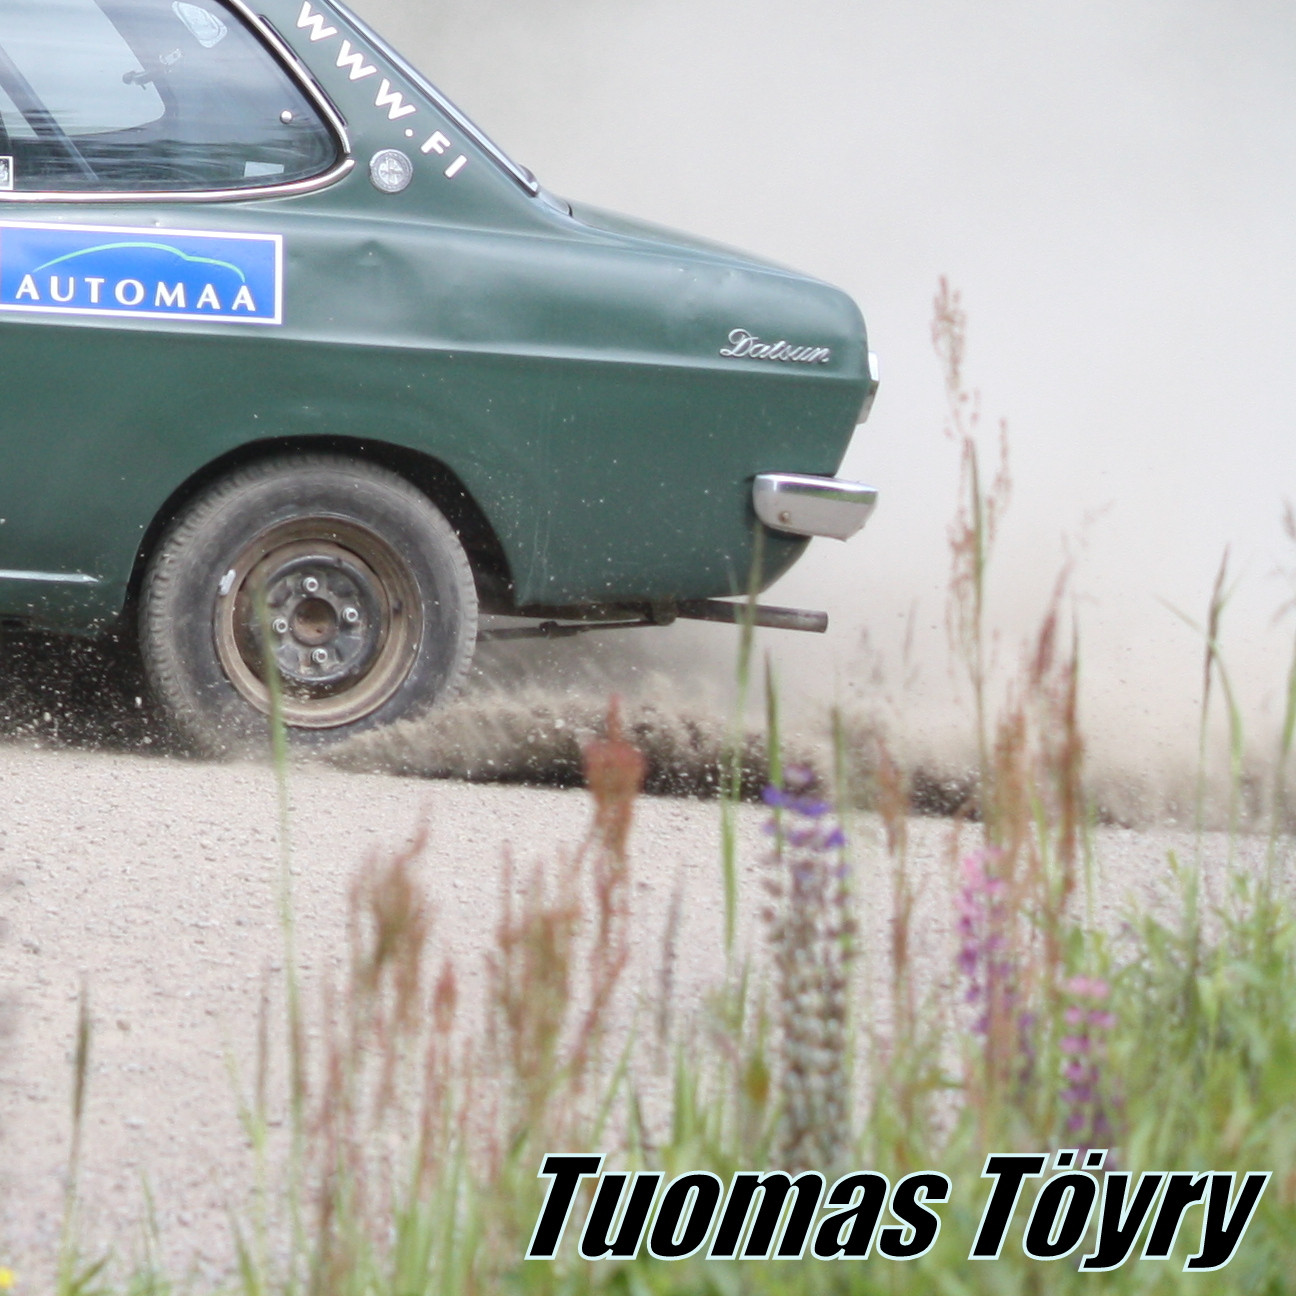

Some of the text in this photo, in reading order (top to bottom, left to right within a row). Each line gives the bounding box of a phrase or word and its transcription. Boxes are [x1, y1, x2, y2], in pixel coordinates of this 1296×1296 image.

[297, 0, 467, 178] WWW.FI
[15, 274, 256, 312] AUTOMAA
[719, 328, 830, 363] Datsun
